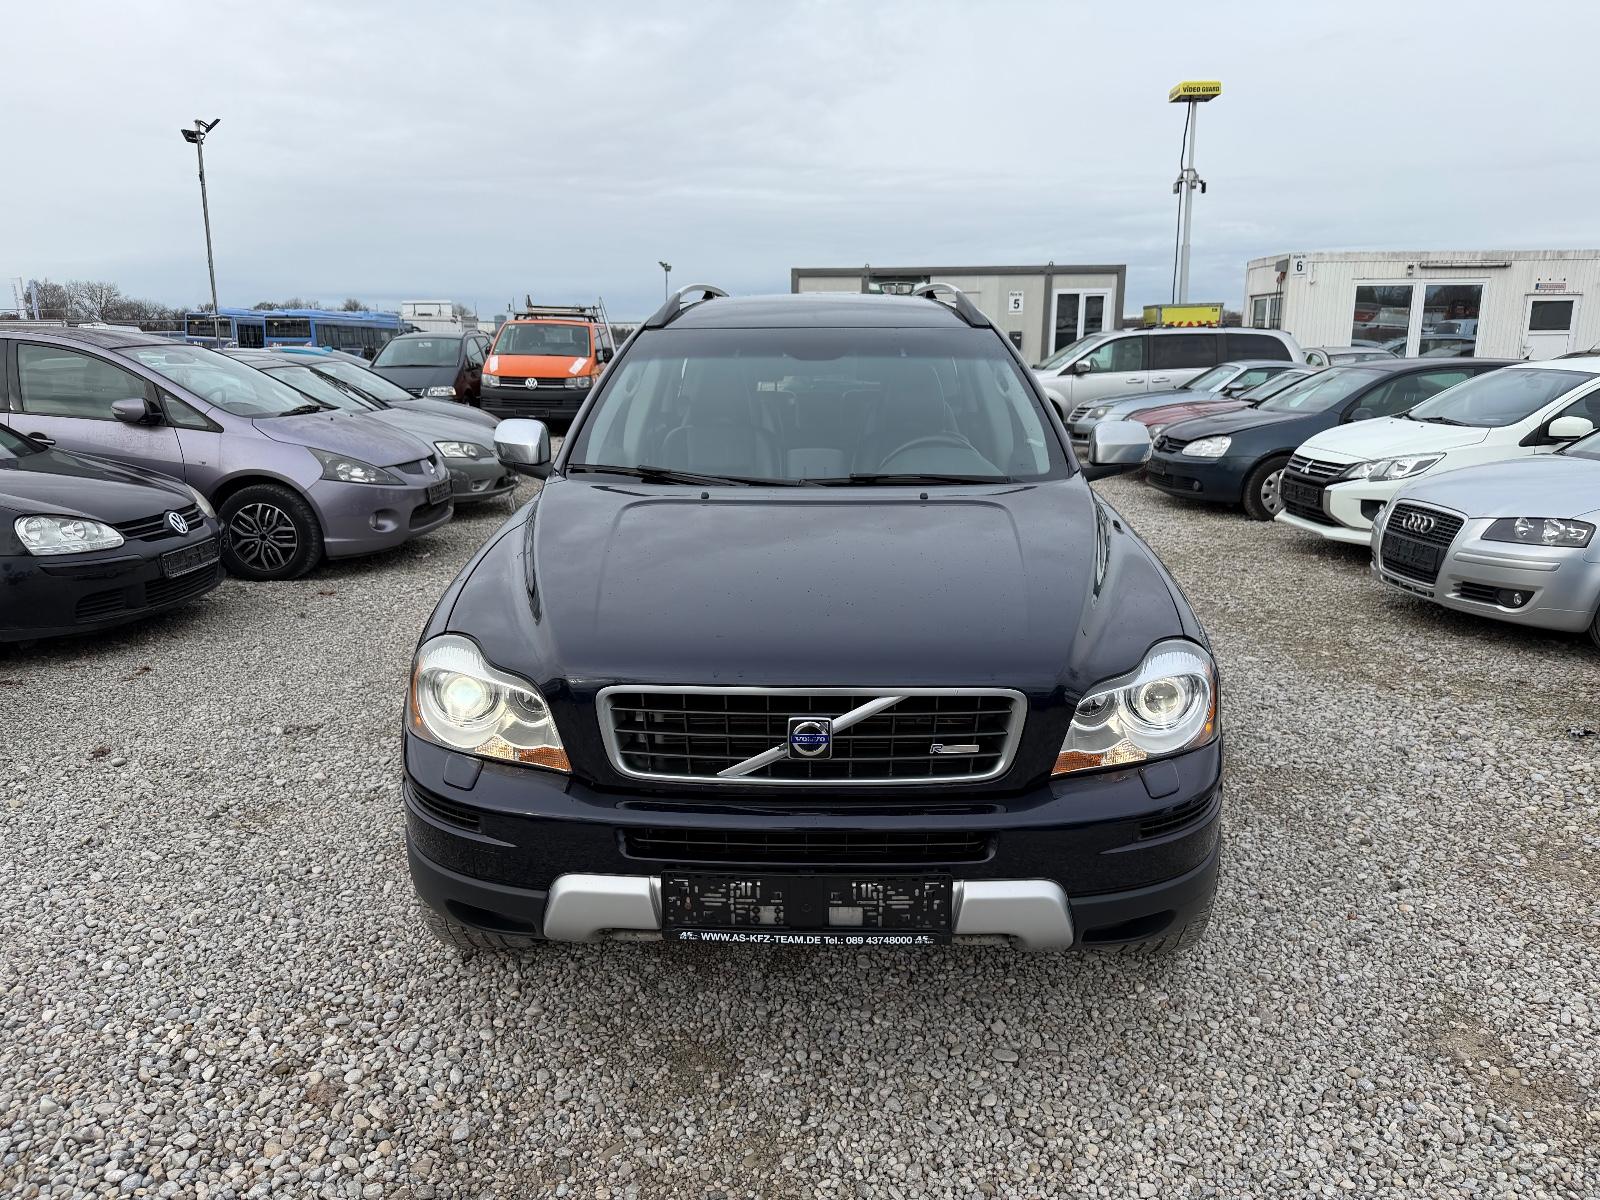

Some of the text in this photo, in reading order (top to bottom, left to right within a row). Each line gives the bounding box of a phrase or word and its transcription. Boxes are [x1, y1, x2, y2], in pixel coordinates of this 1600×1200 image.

[1296, 260, 1303, 273] 6
[1013, 298, 1020, 309] 5
[700, 932, 821, 944] WWW.AS-KFZ-TEAM.DE
[824, 935, 844, 944] Tel.:
[846, 935, 864, 944] 089
[866, 935, 913, 944] 43748000
